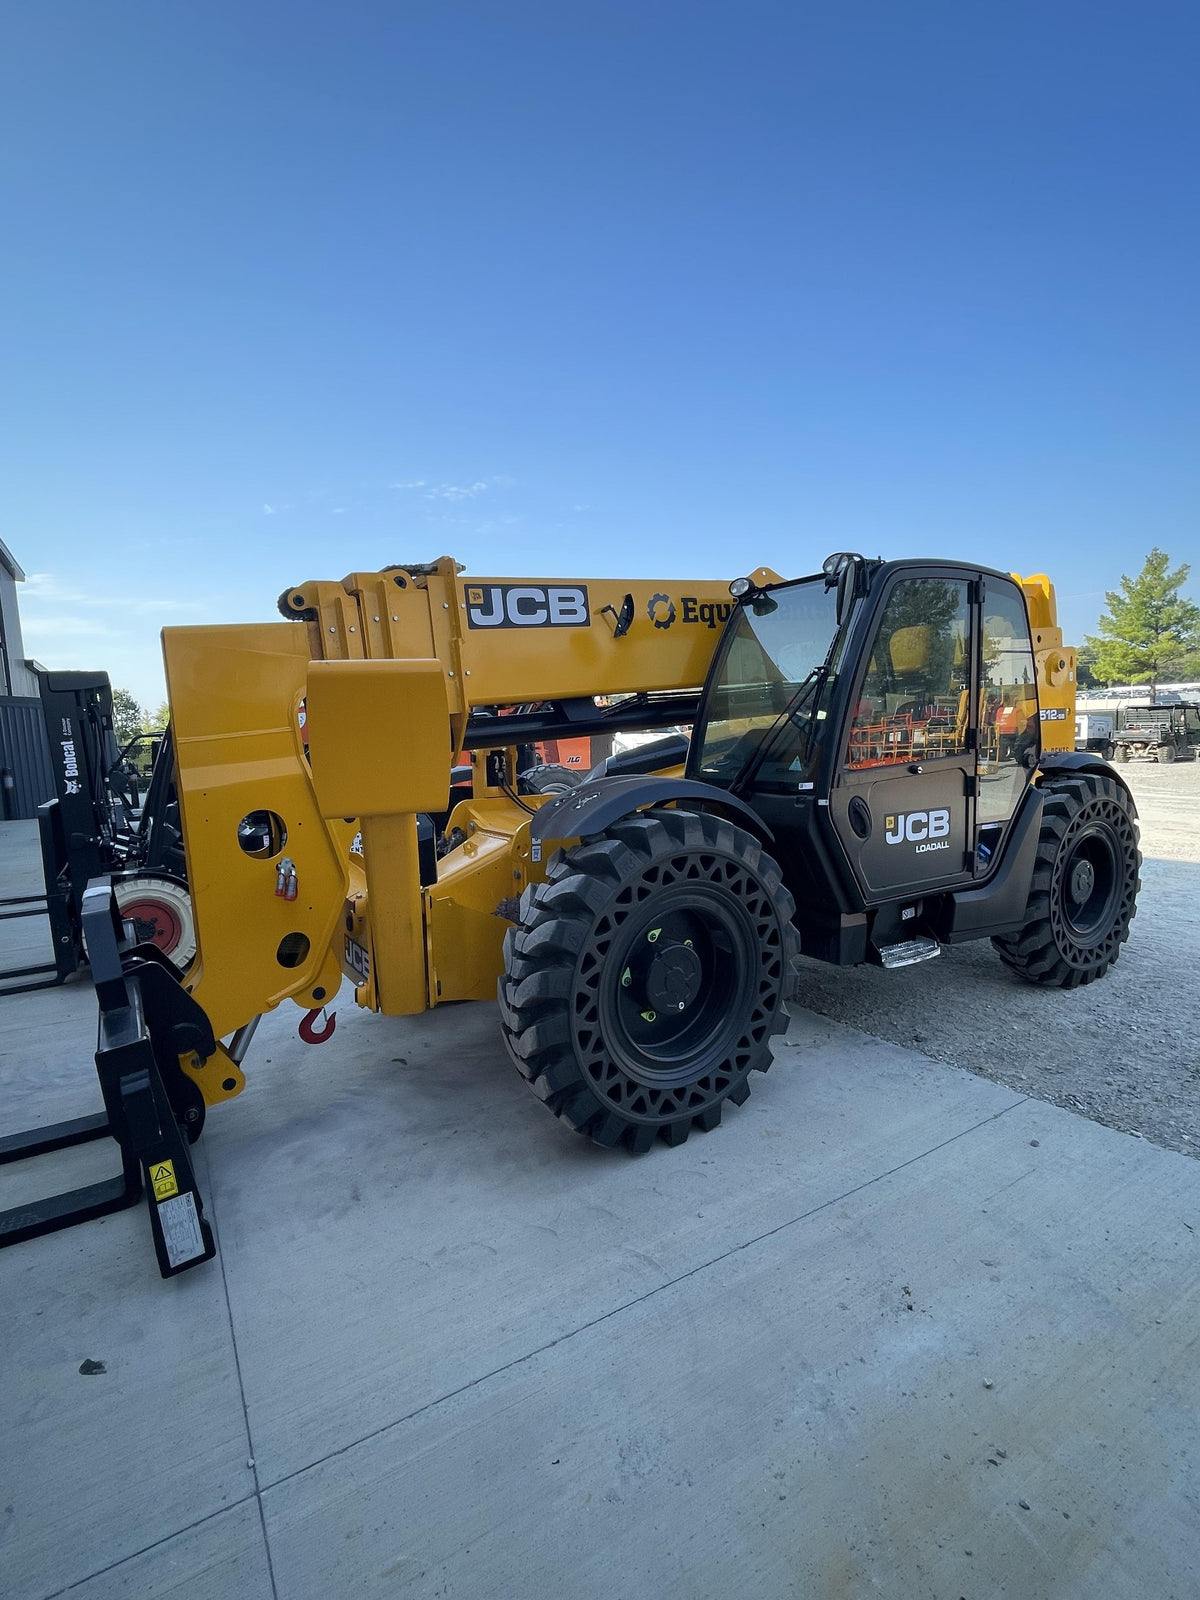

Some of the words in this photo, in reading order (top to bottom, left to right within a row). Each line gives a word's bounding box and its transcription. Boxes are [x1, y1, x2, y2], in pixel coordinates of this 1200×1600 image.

[470, 588, 587, 625] JCB
[681, 598, 738, 629] Equ
[60, 741, 78, 777] Bobcat
[885, 810, 950, 844] JCB
[915, 841, 950, 853] LOADALL
